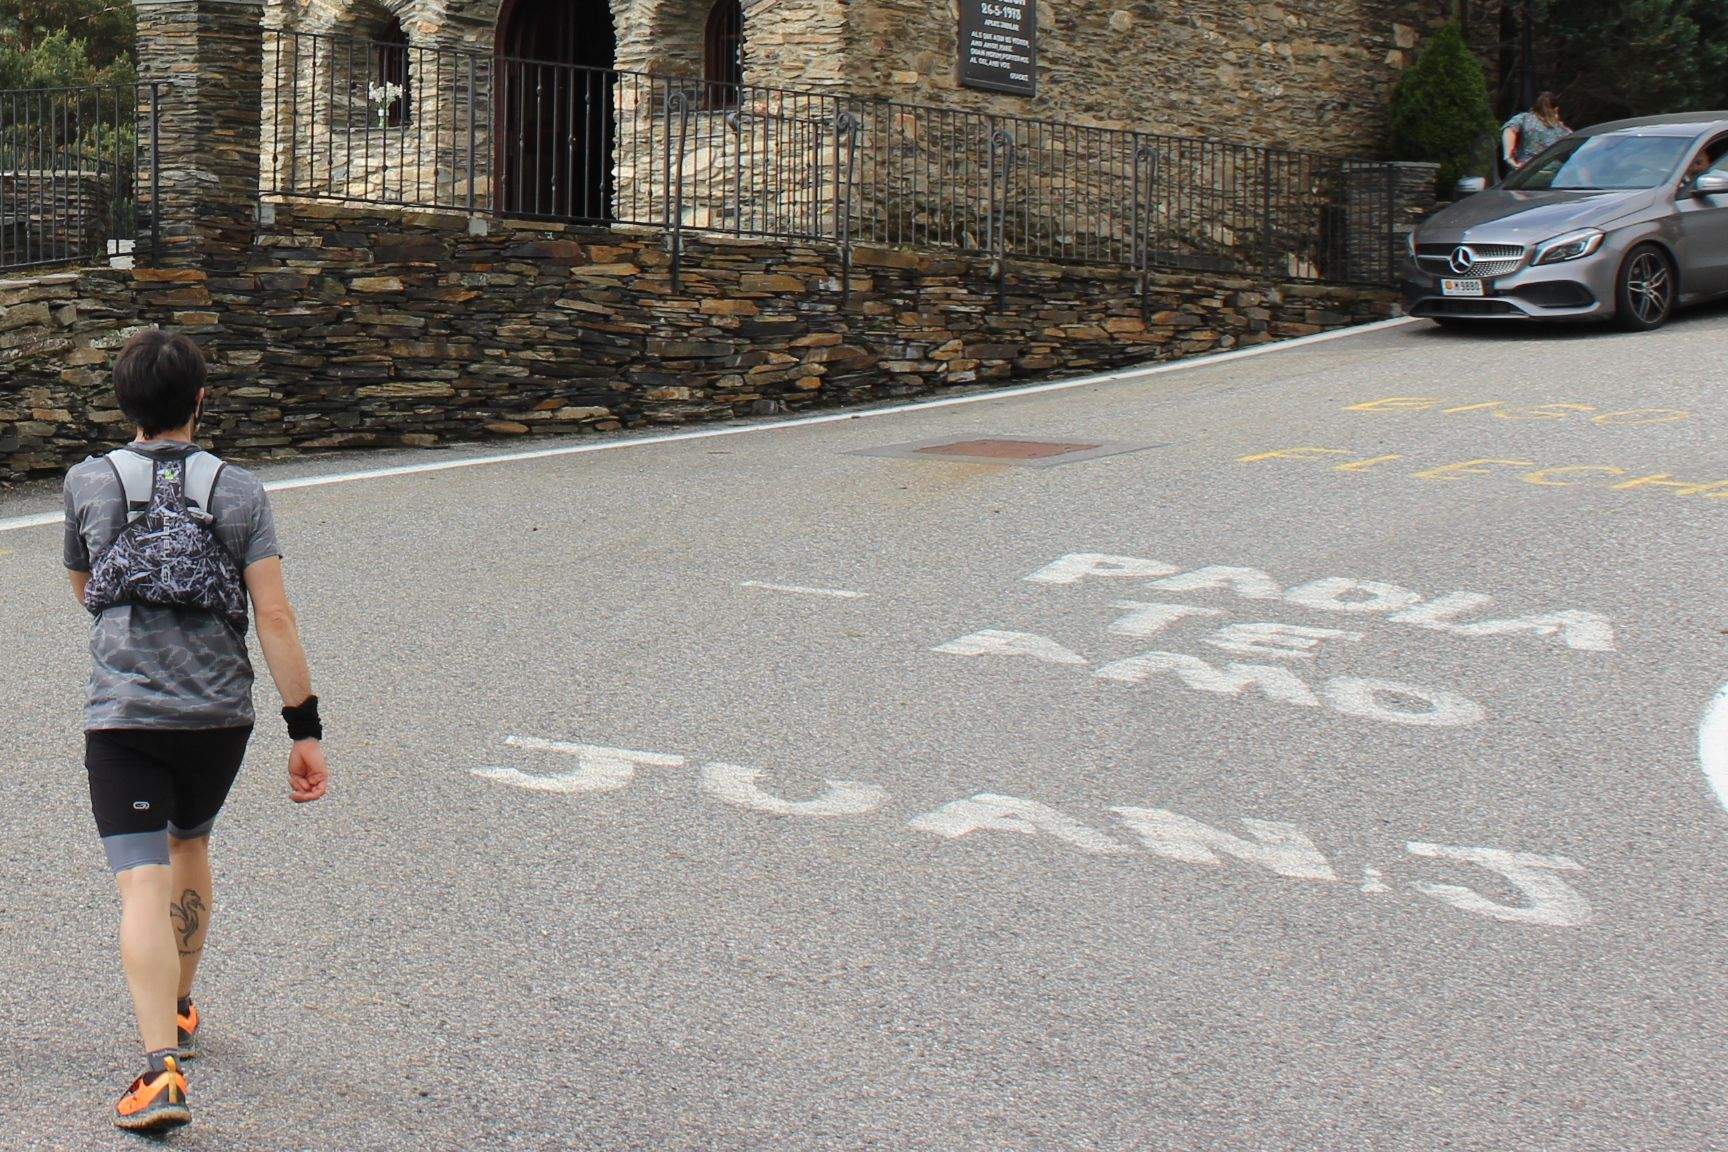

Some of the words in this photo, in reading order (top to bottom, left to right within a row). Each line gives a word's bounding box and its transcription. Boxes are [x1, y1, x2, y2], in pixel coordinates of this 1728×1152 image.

[1022, 552, 1616, 651] PAOLA
[1106, 599, 1366, 658] TE
[929, 628, 1487, 727] AMO
